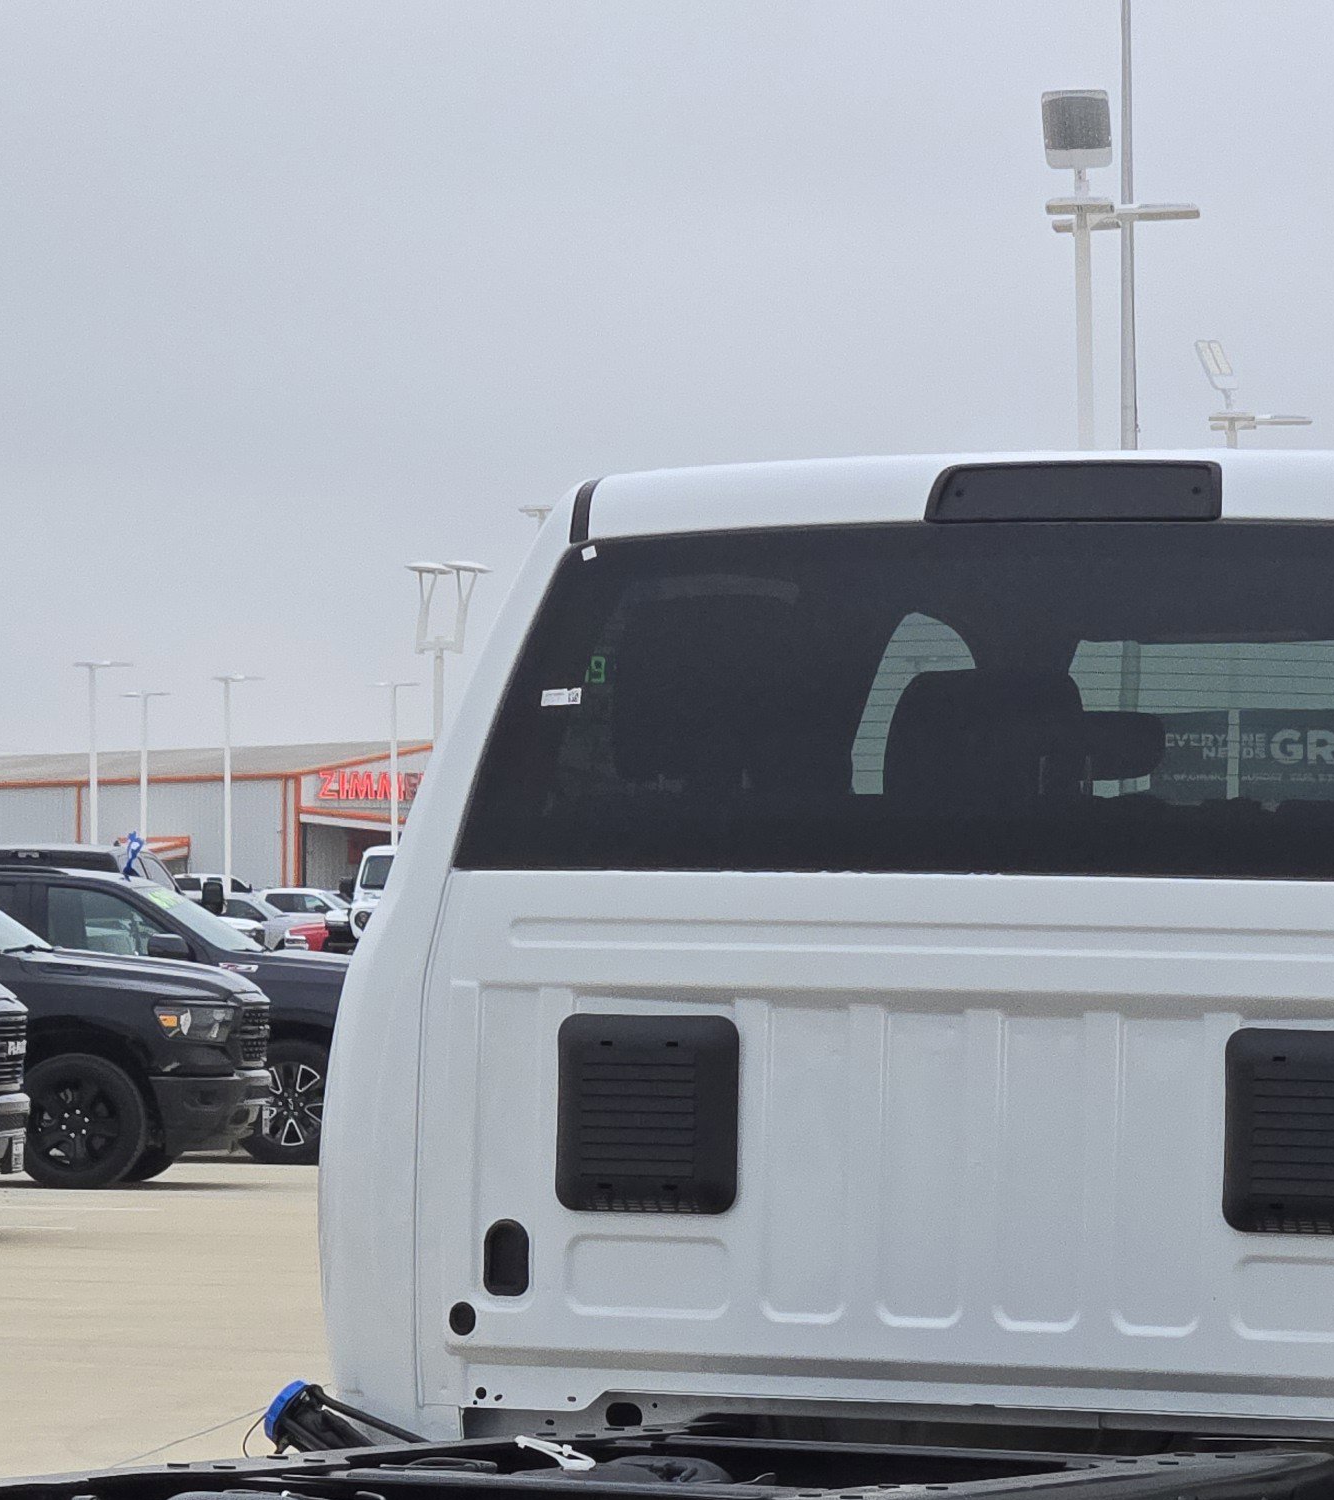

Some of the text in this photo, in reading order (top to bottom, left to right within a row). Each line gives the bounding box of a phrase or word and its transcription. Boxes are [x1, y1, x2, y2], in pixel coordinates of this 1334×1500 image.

[1165, 733, 1267, 747] EVERYNE
[1203, 747, 1267, 760] NEDS
[318, 770, 424, 801] ZIMME
